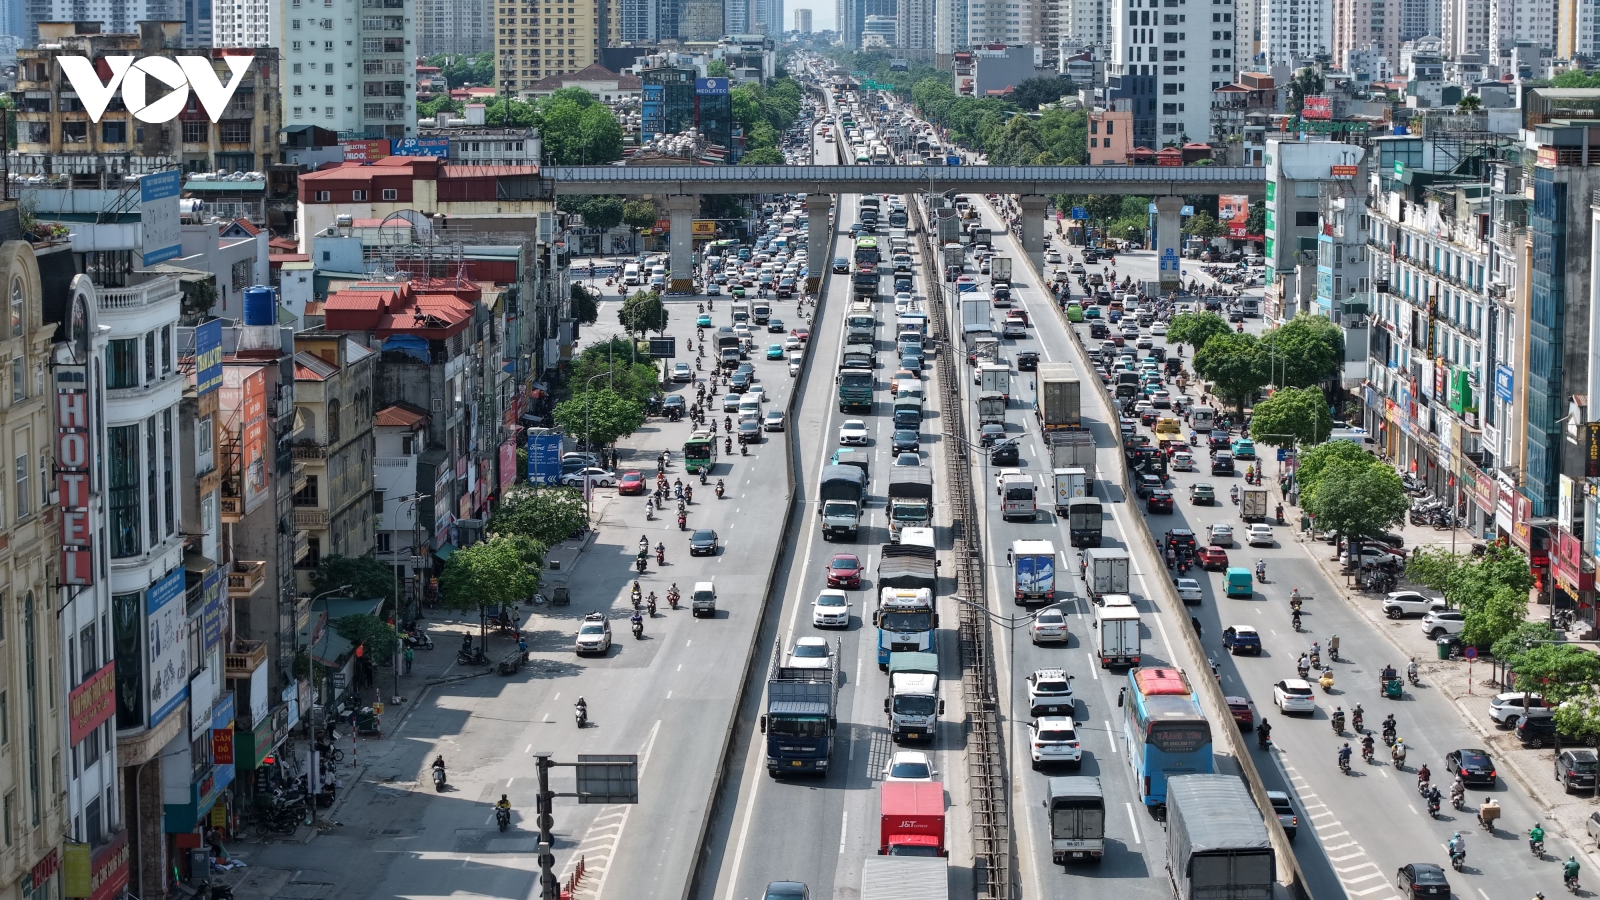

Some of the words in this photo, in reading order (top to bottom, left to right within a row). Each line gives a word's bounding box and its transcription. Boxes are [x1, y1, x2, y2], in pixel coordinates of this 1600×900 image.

[1280, 116, 1368, 135] Kangaroo
[404, 139, 416, 148] SP
[60, 394, 86, 585] HOTEL
[1156, 732, 1182, 740] TĂNG
[1186, 731, 1202, 740] TÍN
